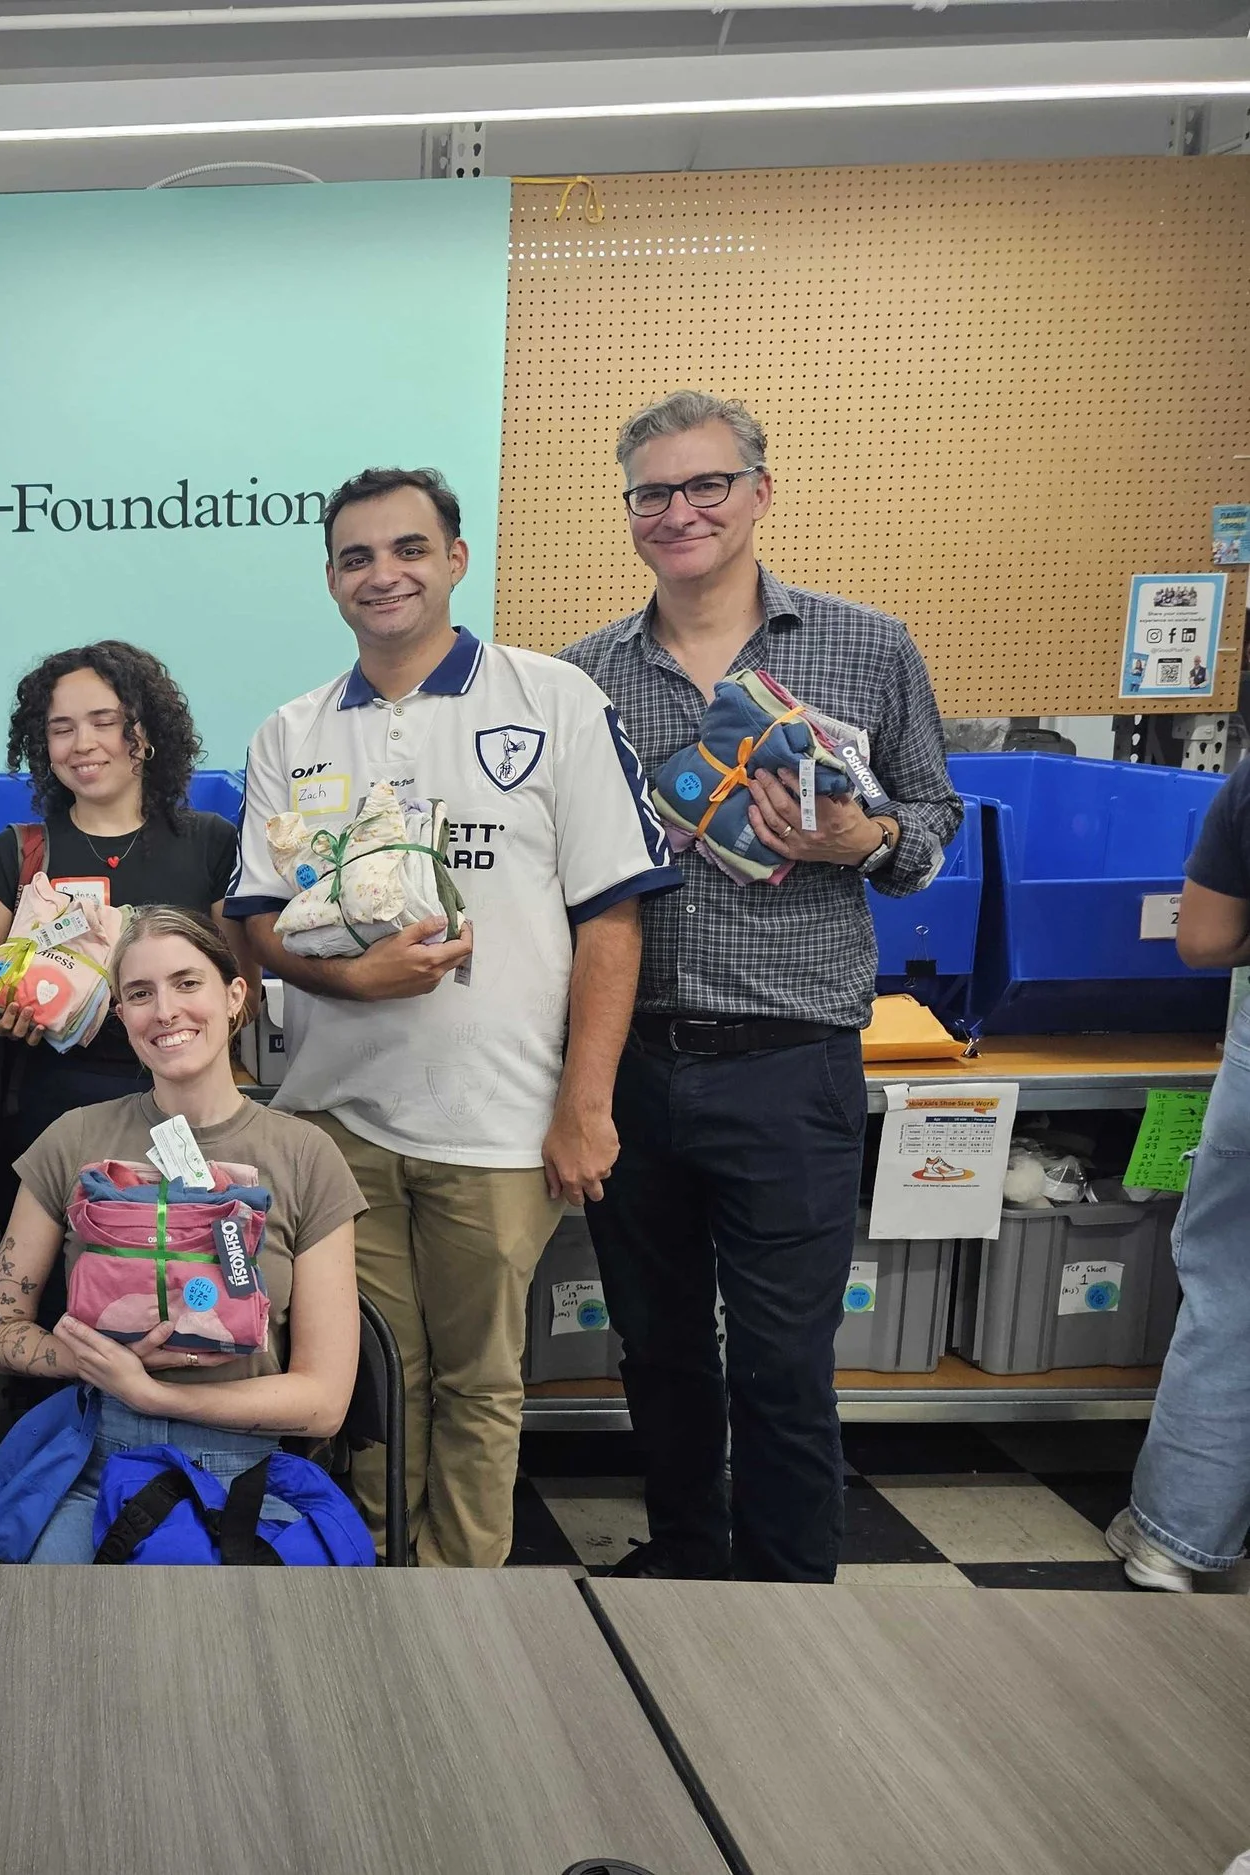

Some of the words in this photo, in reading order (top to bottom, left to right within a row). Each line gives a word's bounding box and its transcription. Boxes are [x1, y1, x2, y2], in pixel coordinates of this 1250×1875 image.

[843, 746, 882, 799] OSHKOSH
[298, 784, 327, 802] Zach
[222, 1221, 249, 1287] OSHKOSH
[1080, 1273, 1088, 1285] 1
